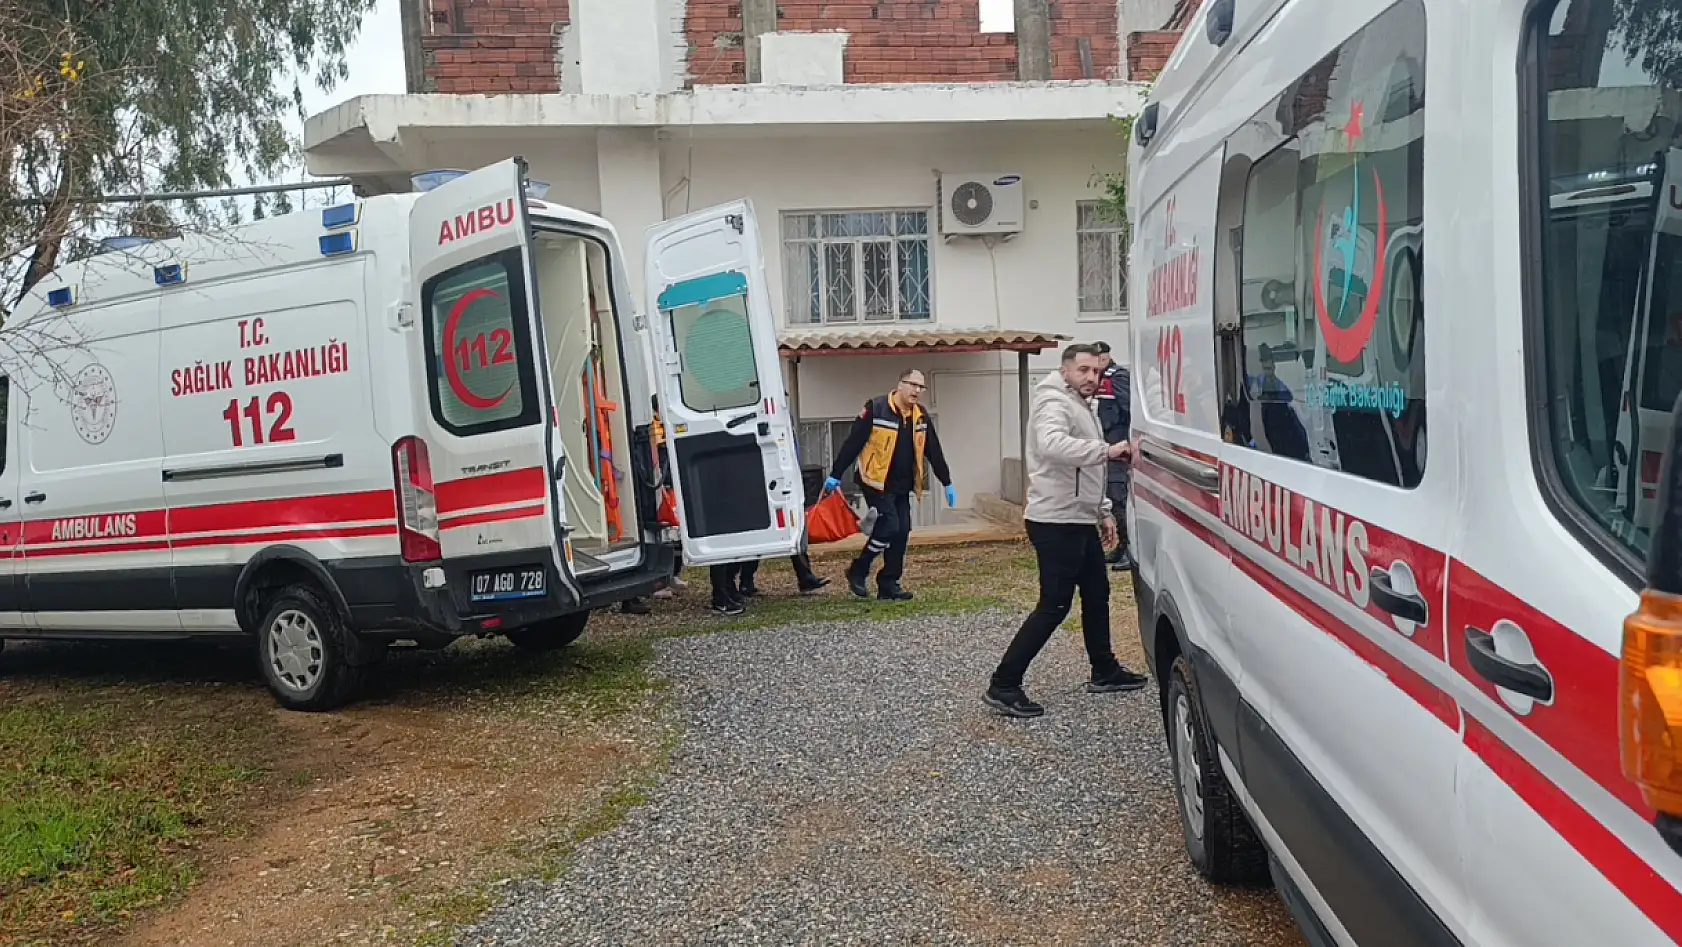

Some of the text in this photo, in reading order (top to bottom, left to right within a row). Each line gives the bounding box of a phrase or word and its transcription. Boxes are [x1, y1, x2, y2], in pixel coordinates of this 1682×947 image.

[438, 198, 516, 245] AMBU
[238, 317, 269, 348] T.C.
[455, 327, 514, 371] 112
[171, 337, 349, 396] SAĞLIK BAKANLIĞI
[1157, 323, 1186, 414] 112
[223, 391, 296, 446] 112
[1349, 381, 1404, 418] Bakanlığı
[52, 514, 137, 540] AMBULANS
[1221, 465, 1370, 609] AMBULANS
[476, 575, 490, 593] 07
[520, 571, 543, 590] 728
